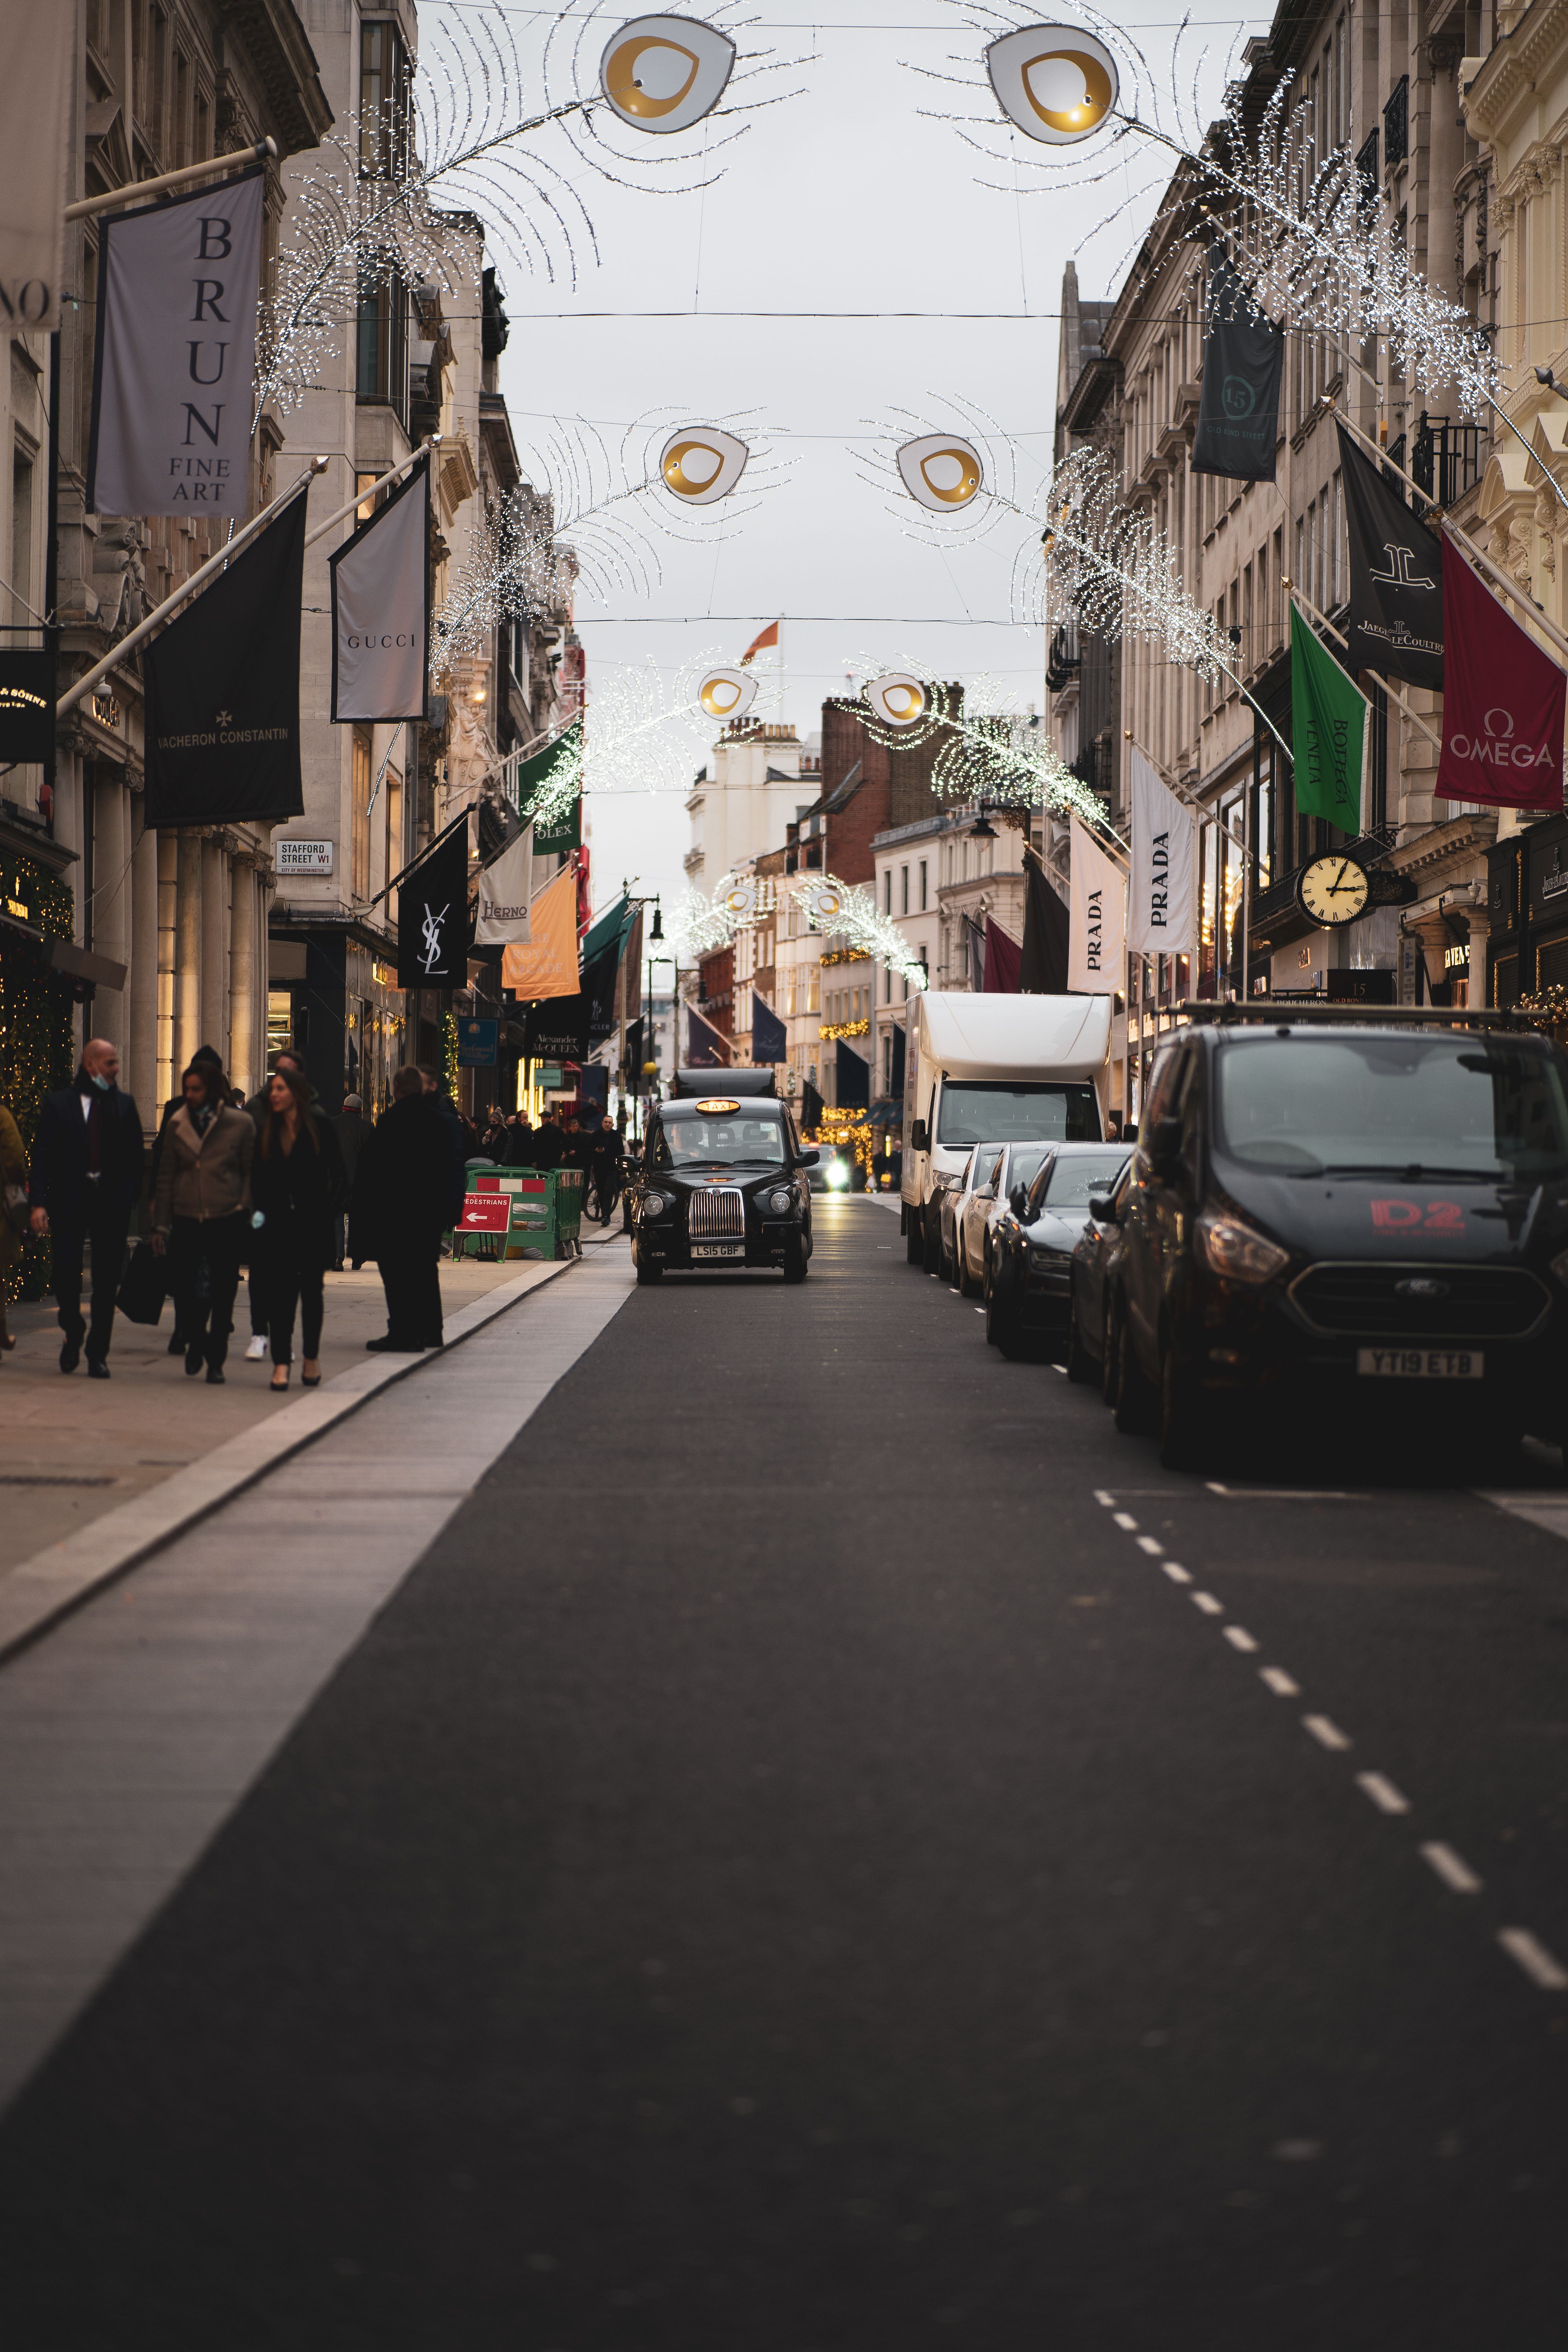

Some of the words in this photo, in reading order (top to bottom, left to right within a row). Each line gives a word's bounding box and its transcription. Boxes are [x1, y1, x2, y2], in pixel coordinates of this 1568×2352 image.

[180, 217, 232, 446] BRUN
[1224, 428, 1239, 437] BOND
[1242, 431, 1265, 440] STREET
[169, 458, 230, 478] FINE
[172, 483, 225, 501] ART
[347, 634, 415, 649] GUCCI
[158, 733, 216, 750] VACHERON
[220, 728, 288, 744] CONSTANTIN
[1307, 719, 1321, 784] VENETA
[1450, 734, 1555, 768] OMEGA
[1333, 719, 1348, 804] BOTTEGA
[536, 824, 572, 839] OLEX
[282, 844, 324, 853] STAFFORD
[281, 855, 312, 863] STREET
[318, 855, 329, 863] W1
[1151, 831, 1169, 928] PRADA
[482, 900, 527, 919] HERNO
[1087, 889, 1102, 972] PRADA
[530, 933, 550, 944] HE
[512, 948, 558, 960] ROYAL
[508, 962, 564, 975] ARCADE
[1352, 983, 1366, 996] 15
[536, 1034, 577, 1044] Alexander
[532, 1043, 580, 1054] McQUEEN
[697, 1246, 718, 1256] LS15
[720, 1246, 739, 1255] GBF
